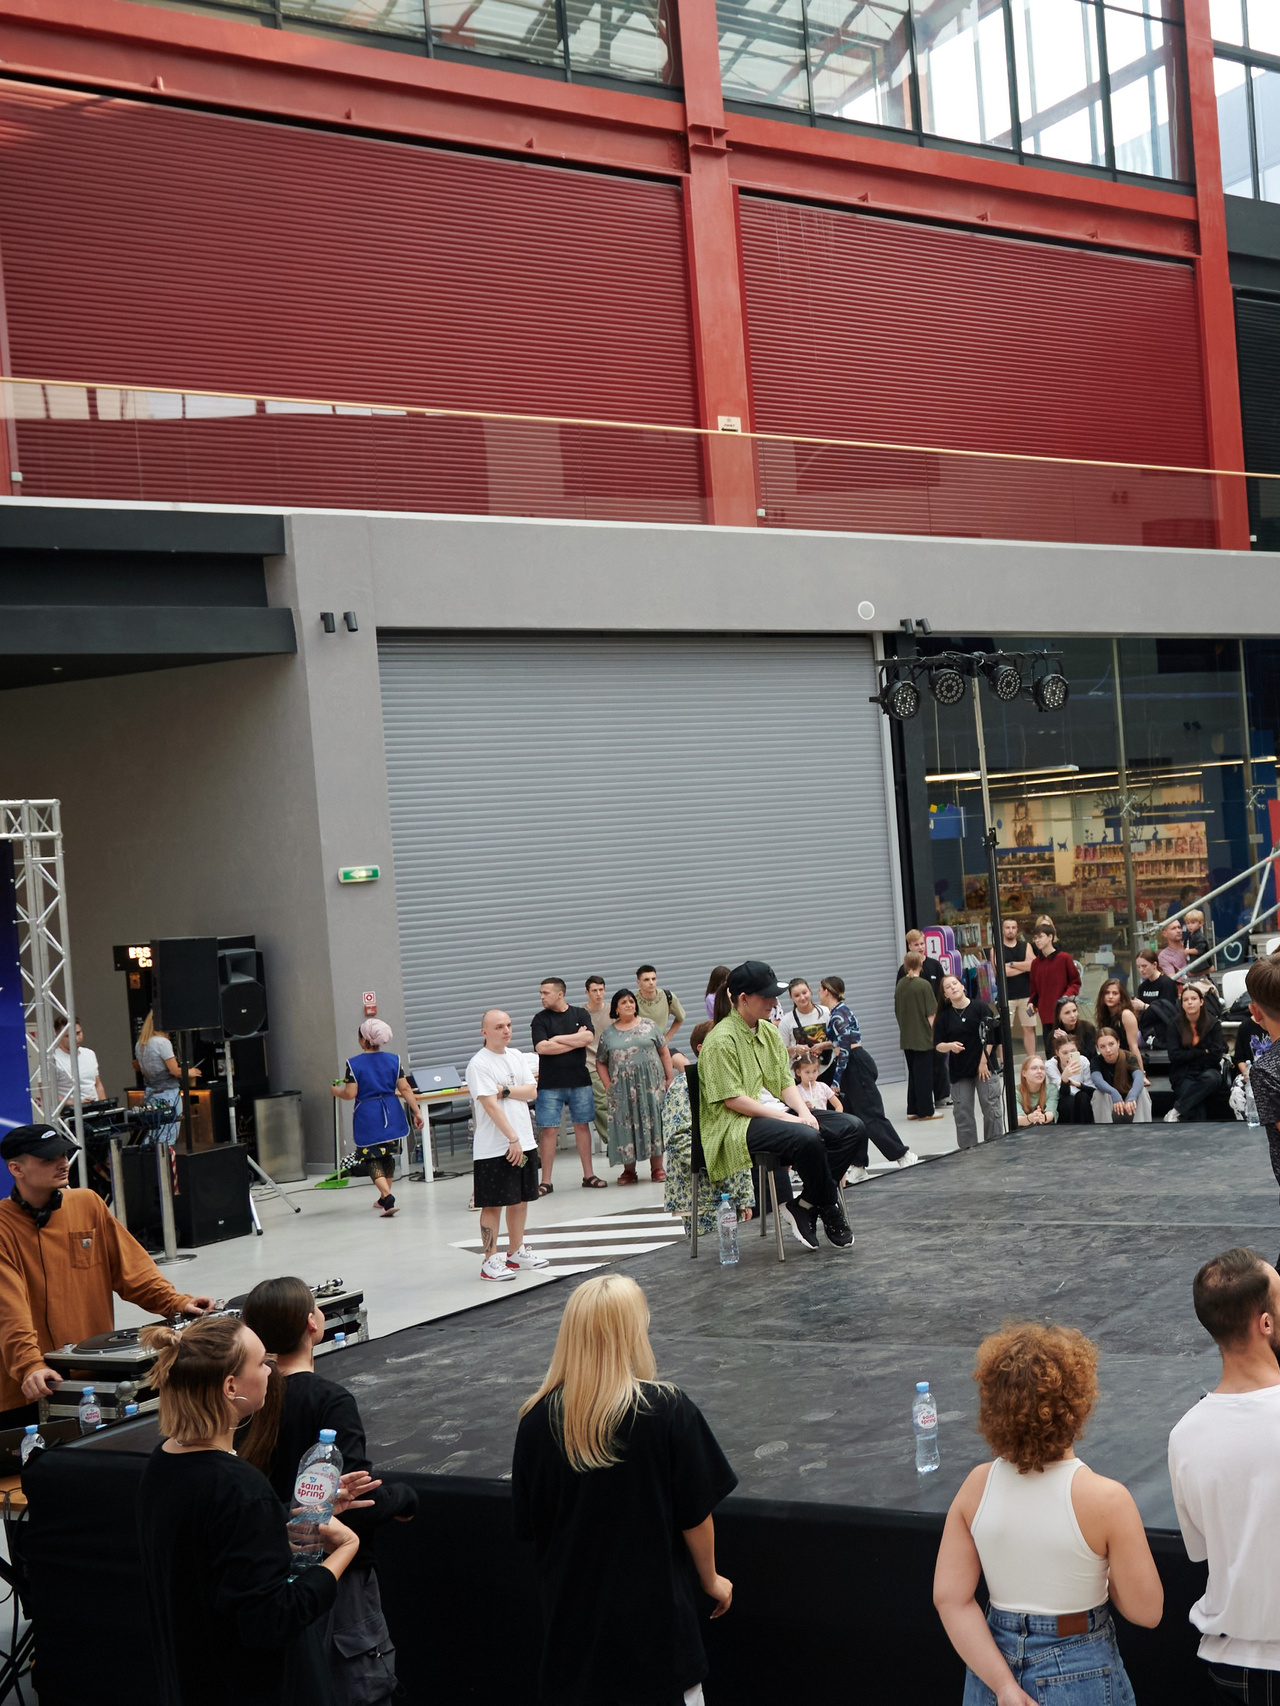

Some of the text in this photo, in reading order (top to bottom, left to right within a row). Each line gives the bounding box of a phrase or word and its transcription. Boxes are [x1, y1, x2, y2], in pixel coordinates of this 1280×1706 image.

[931, 939, 937, 954] 1
[301, 1481, 323, 1491] saint
[297, 1487, 325, 1499] spring
